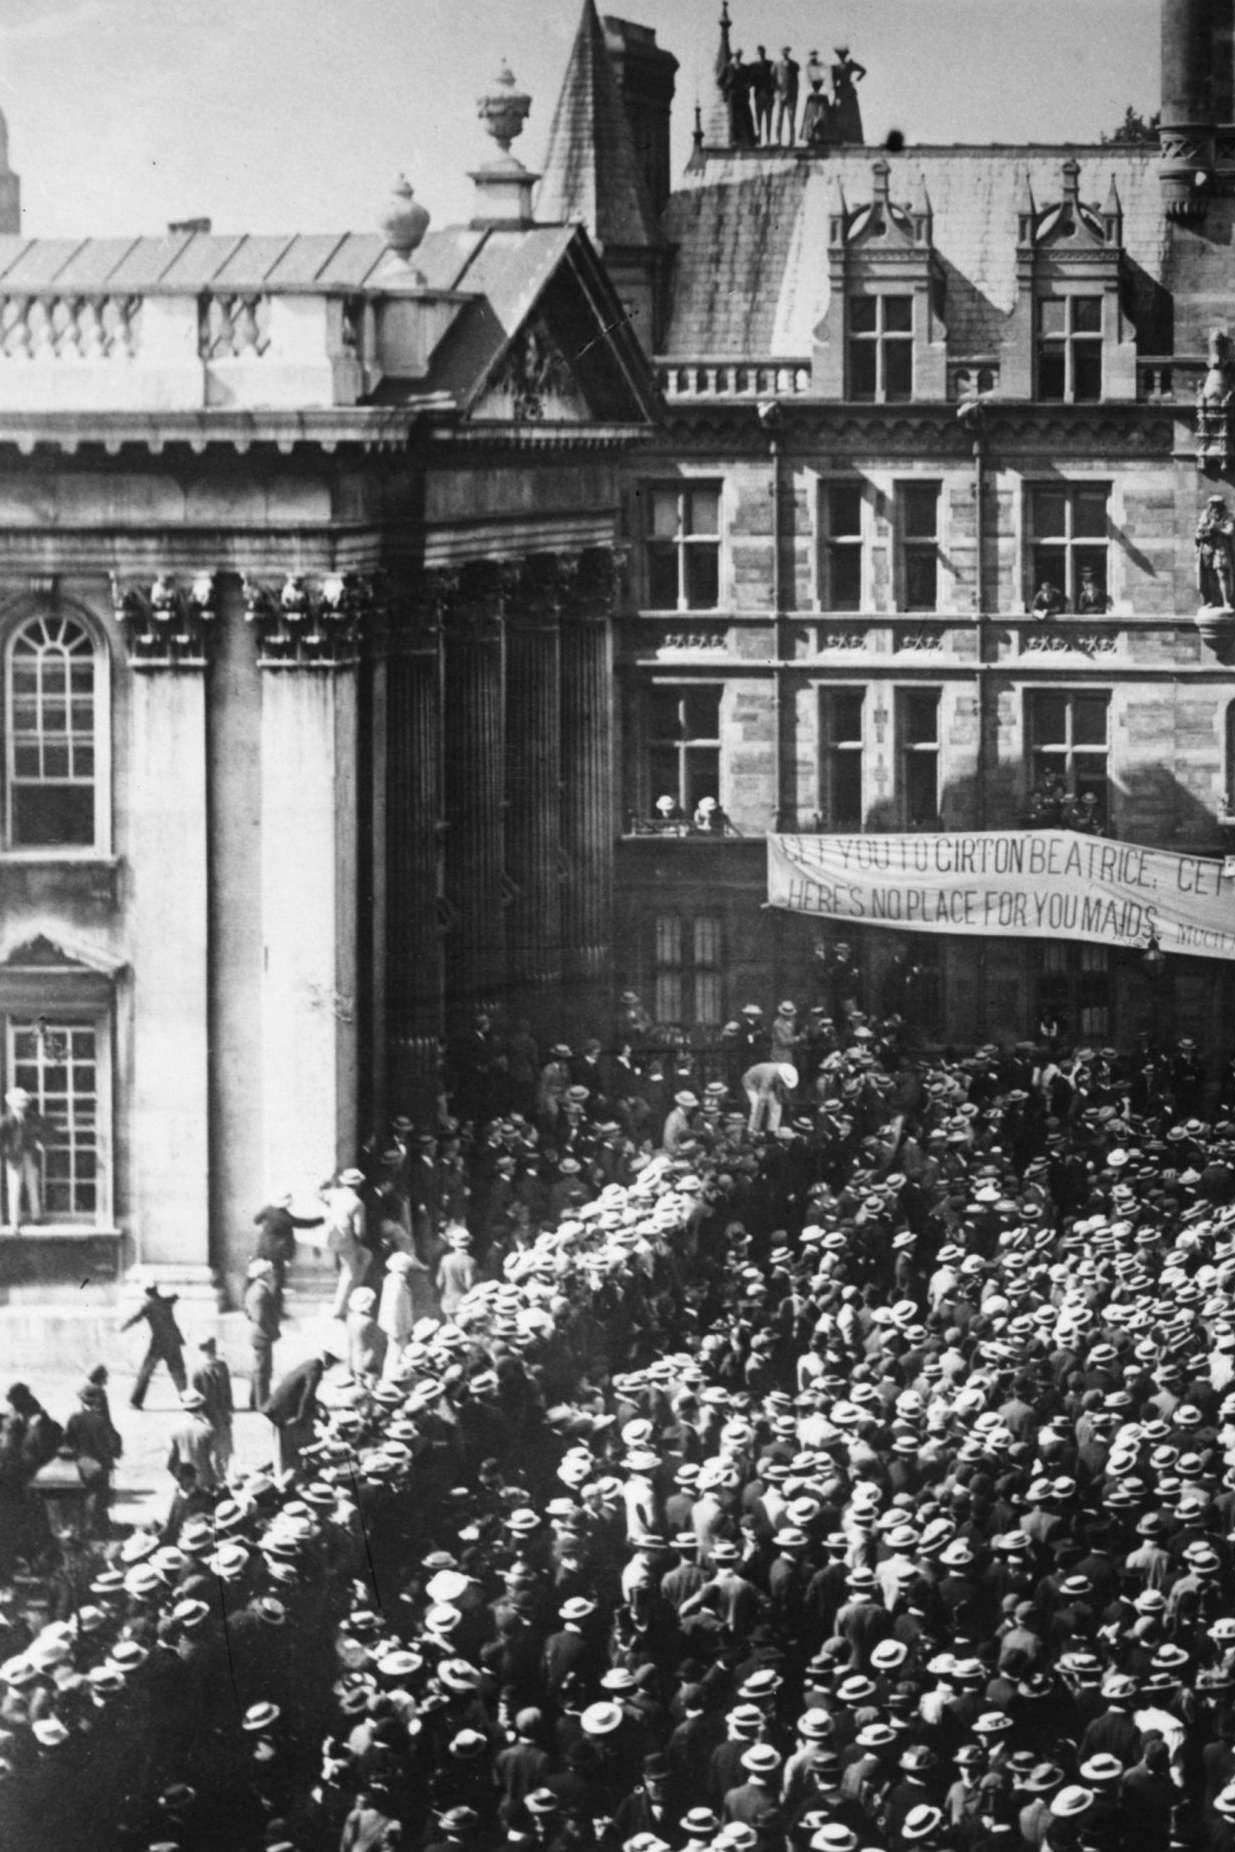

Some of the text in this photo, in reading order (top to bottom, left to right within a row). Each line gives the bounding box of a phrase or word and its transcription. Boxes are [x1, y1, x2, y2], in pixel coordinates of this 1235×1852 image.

[836, 838, 890, 869] YOU
[897, 840, 928, 872] TO
[788, 879, 865, 918] HERE'S
[871, 888, 900, 920] NO
[907, 888, 977, 924] PLACE
[984, 890, 1026, 927] FOR
[1034, 891, 1078, 929] YOU
